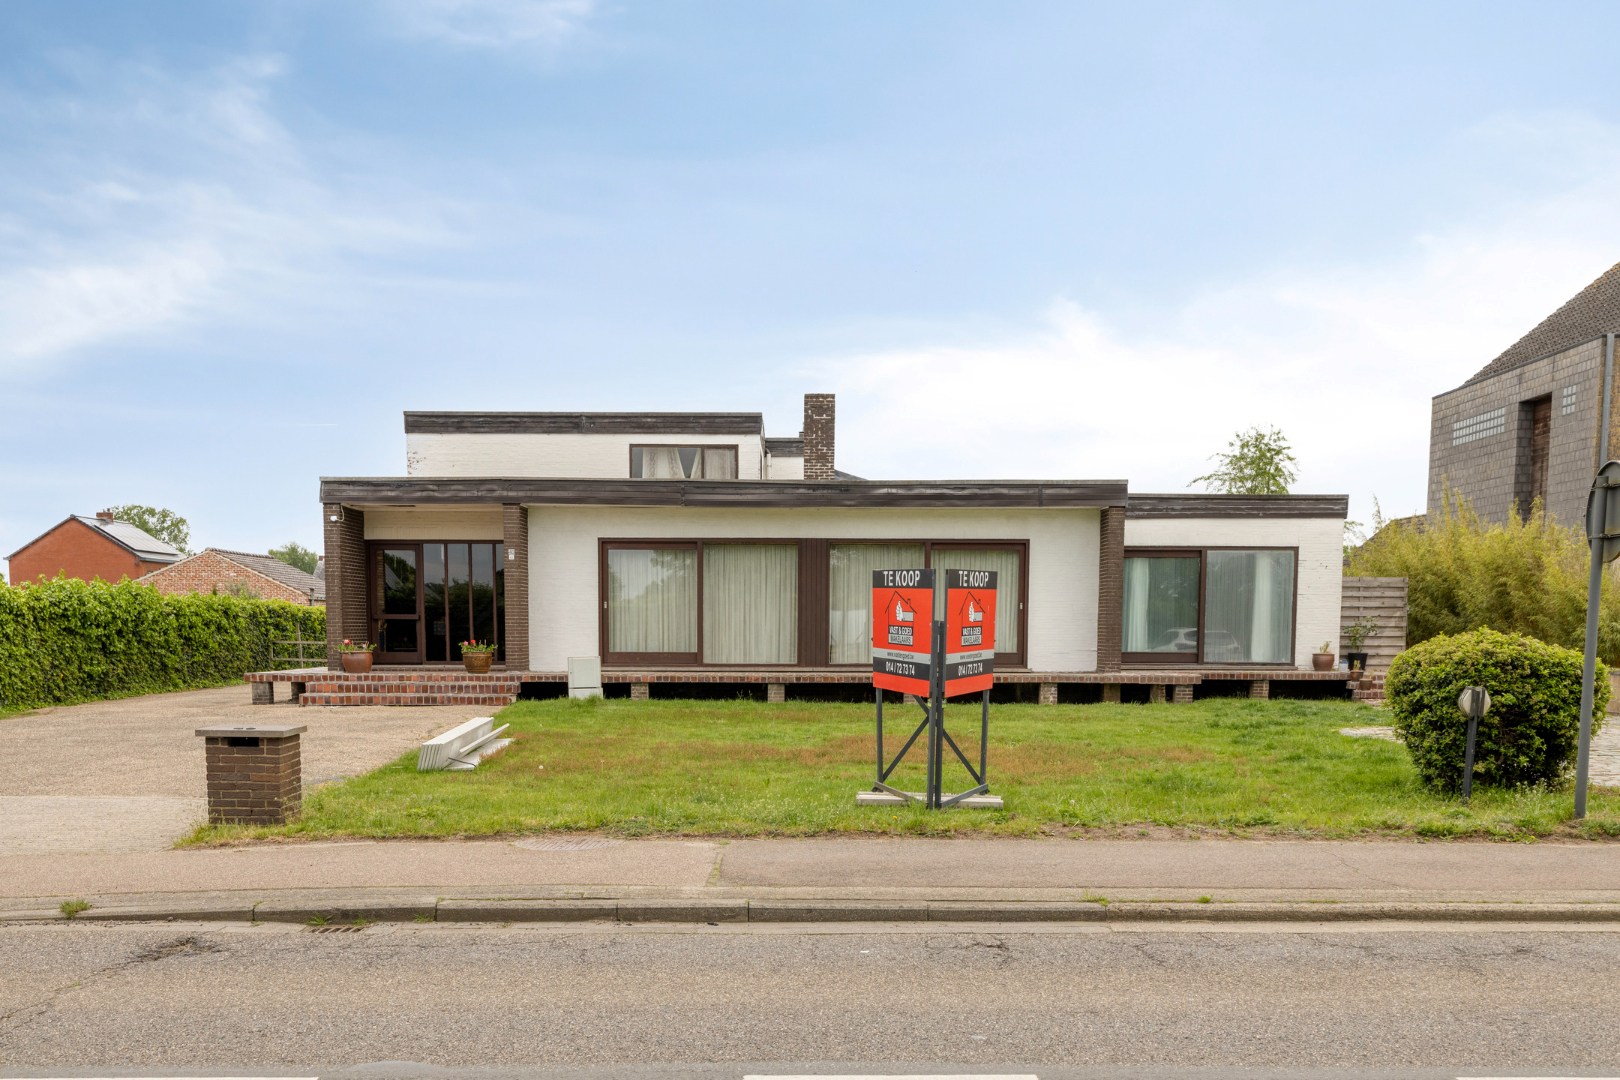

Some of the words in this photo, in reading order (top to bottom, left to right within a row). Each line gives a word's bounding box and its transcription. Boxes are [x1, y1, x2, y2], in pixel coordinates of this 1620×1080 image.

[883, 570, 894, 586] TE
[896, 570, 920, 586] KOOP
[958, 570, 968, 586] TE
[970, 570, 989, 587] KOOP
[897, 663, 902, 674] 72
[903, 664, 909, 675] 73
[909, 664, 915, 676] 74
